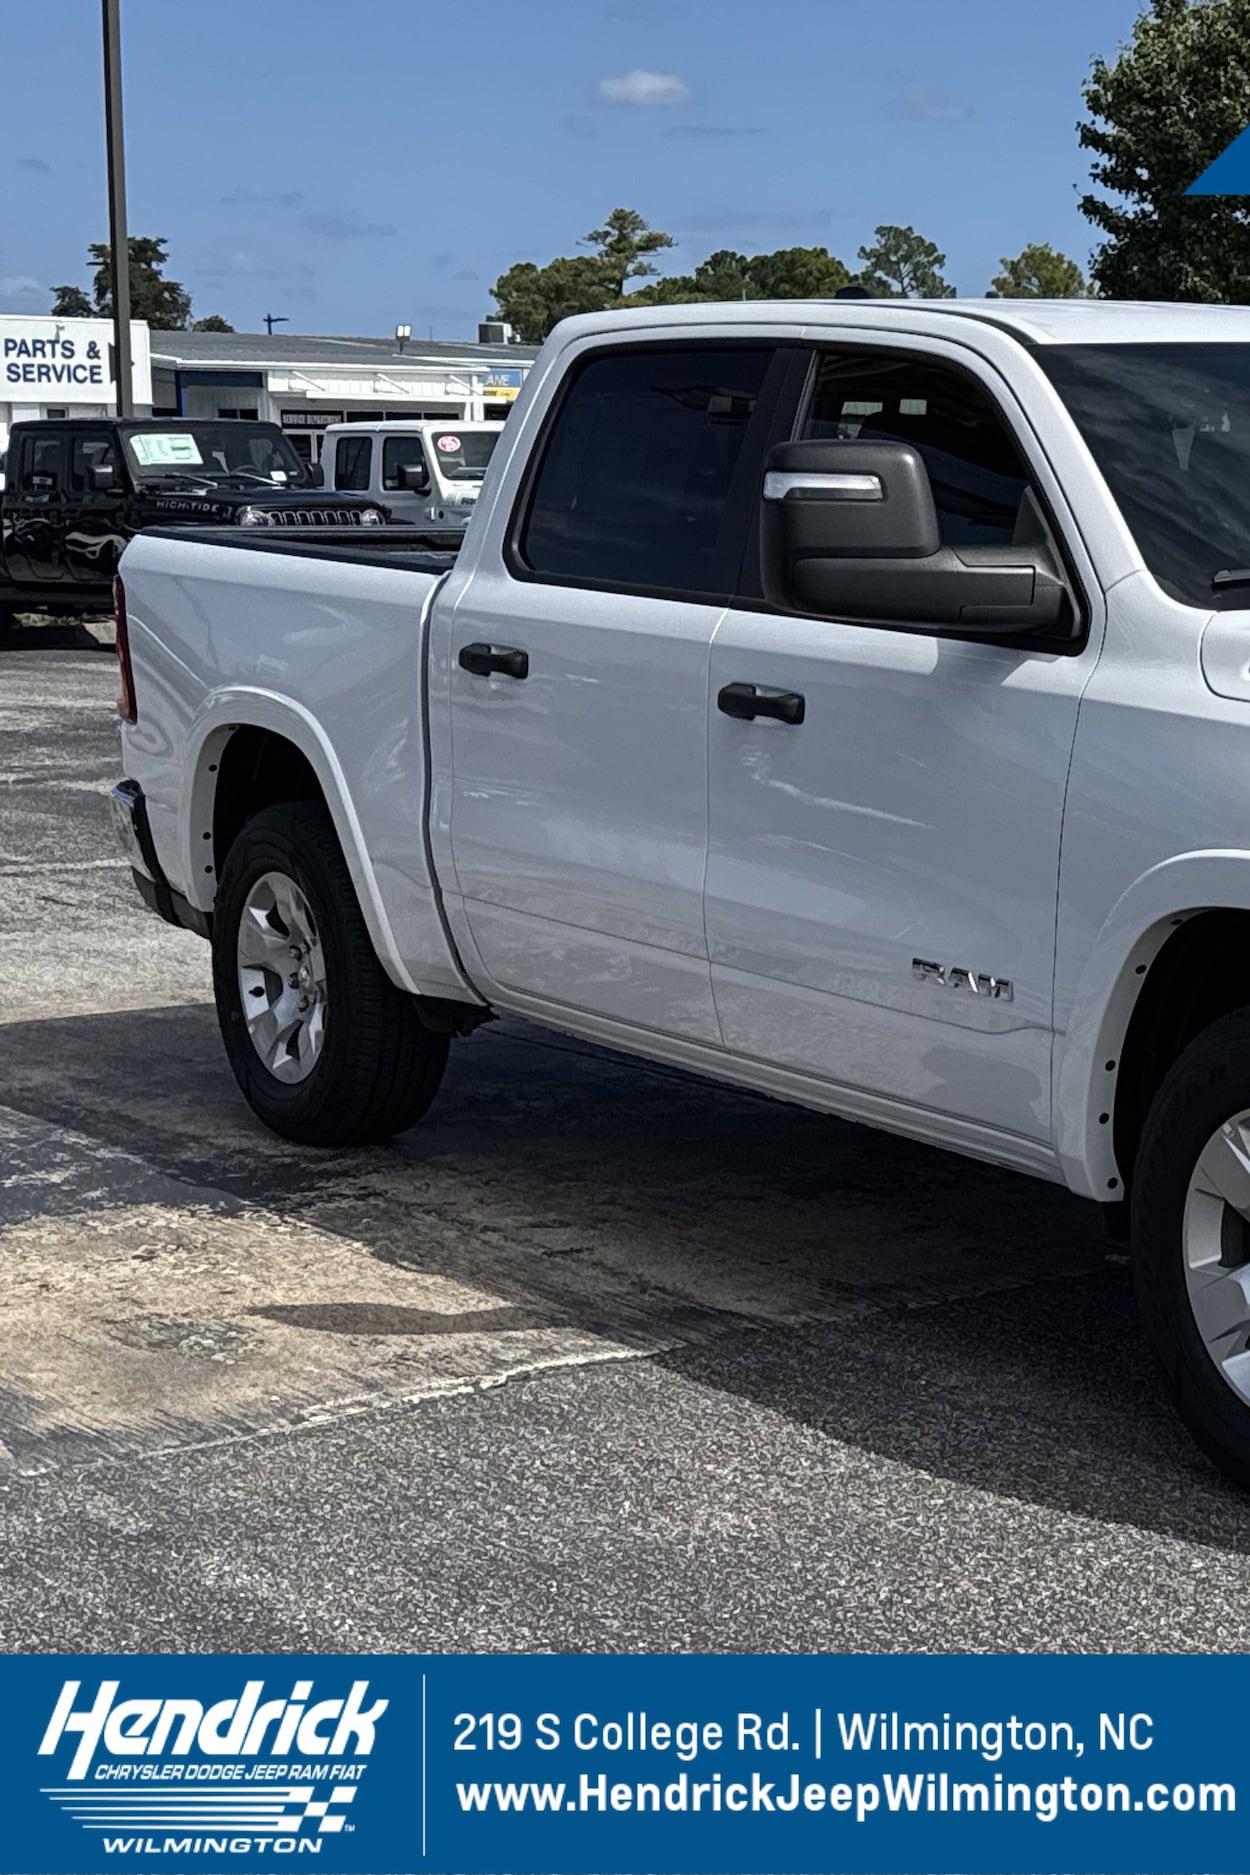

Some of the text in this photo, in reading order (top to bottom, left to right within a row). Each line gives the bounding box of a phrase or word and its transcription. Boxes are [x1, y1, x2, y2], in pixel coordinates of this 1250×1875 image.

[4, 338, 101, 360] PARTS &
[6, 363, 103, 384] SERVICE
[911, 957, 1014, 1002] RAM
